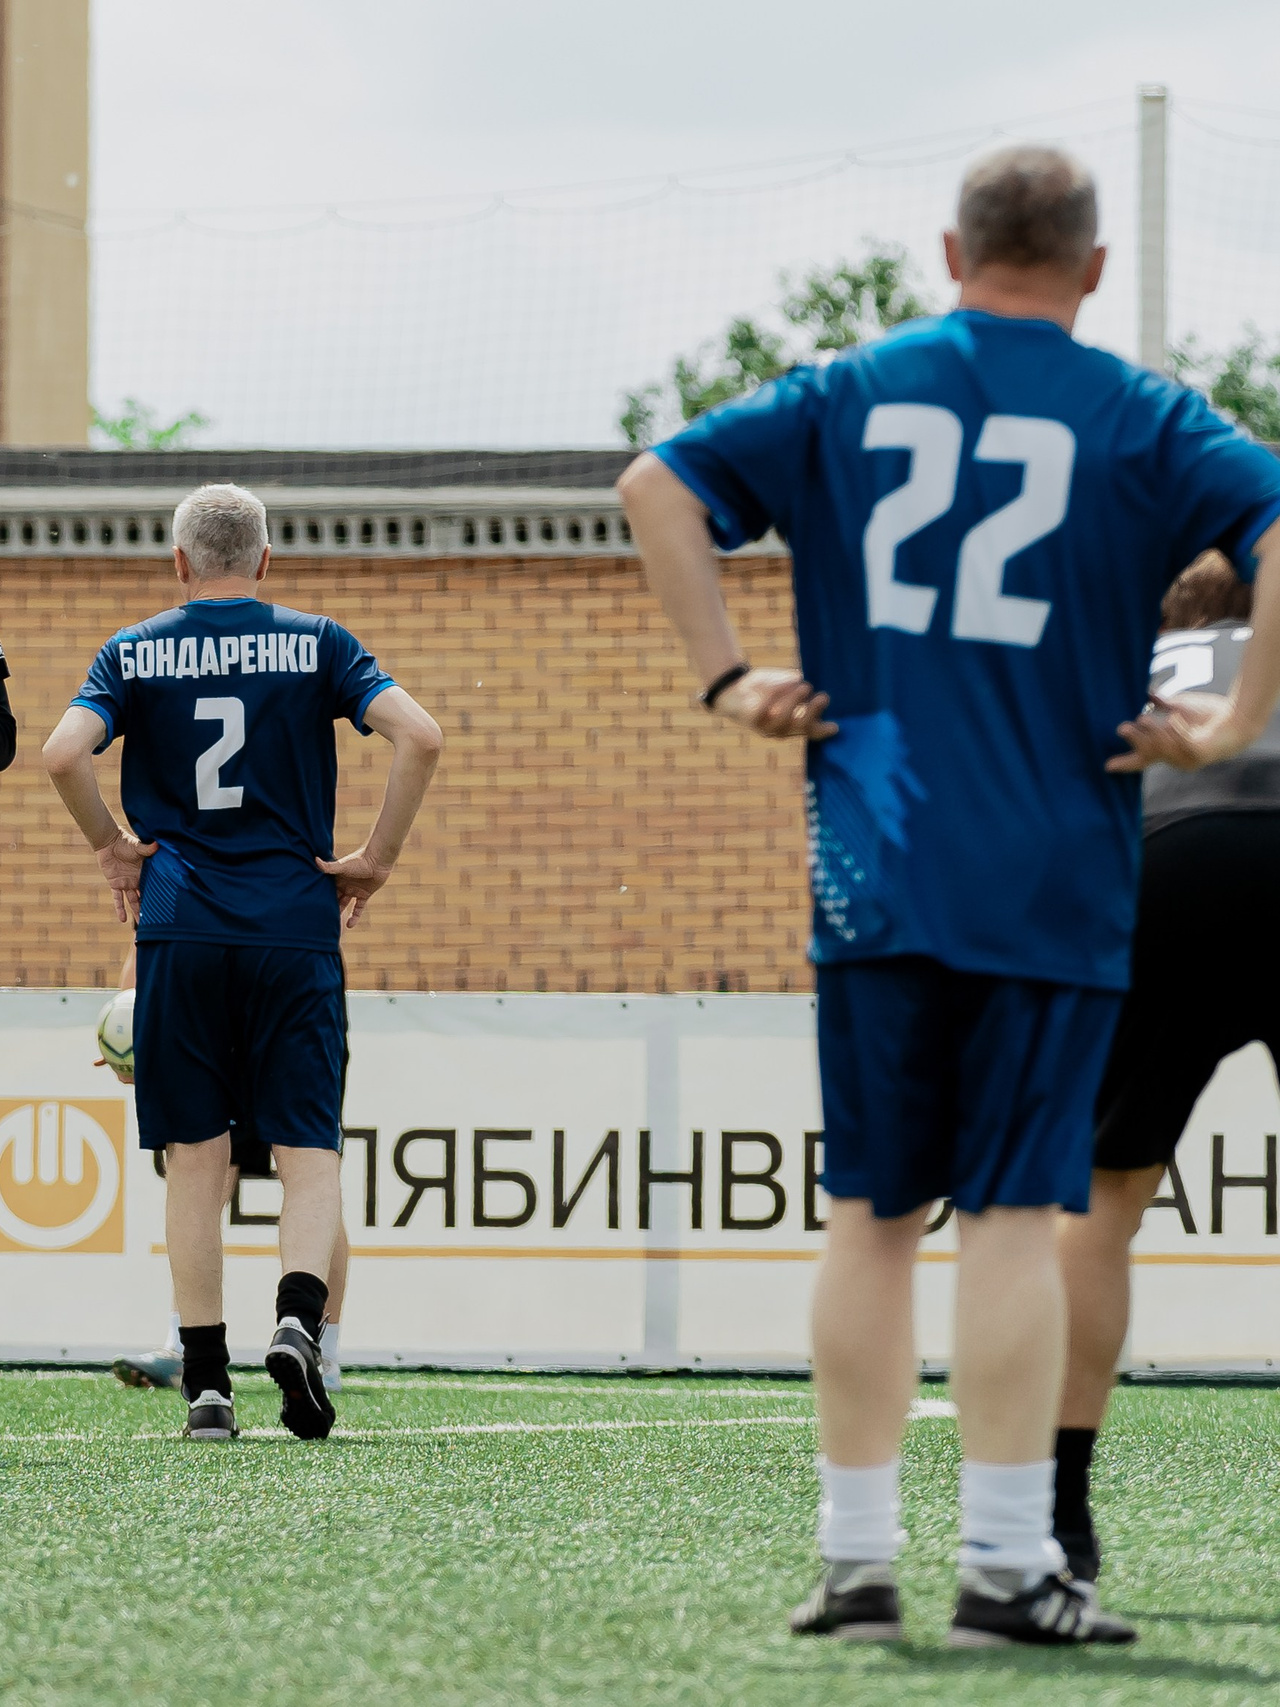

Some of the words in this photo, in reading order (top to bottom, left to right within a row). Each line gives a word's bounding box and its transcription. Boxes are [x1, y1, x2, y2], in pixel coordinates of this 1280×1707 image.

[862, 402, 1078, 648] 22
[119, 633, 318, 680] БОНДАРЕНКО
[194, 697, 246, 810] 2
